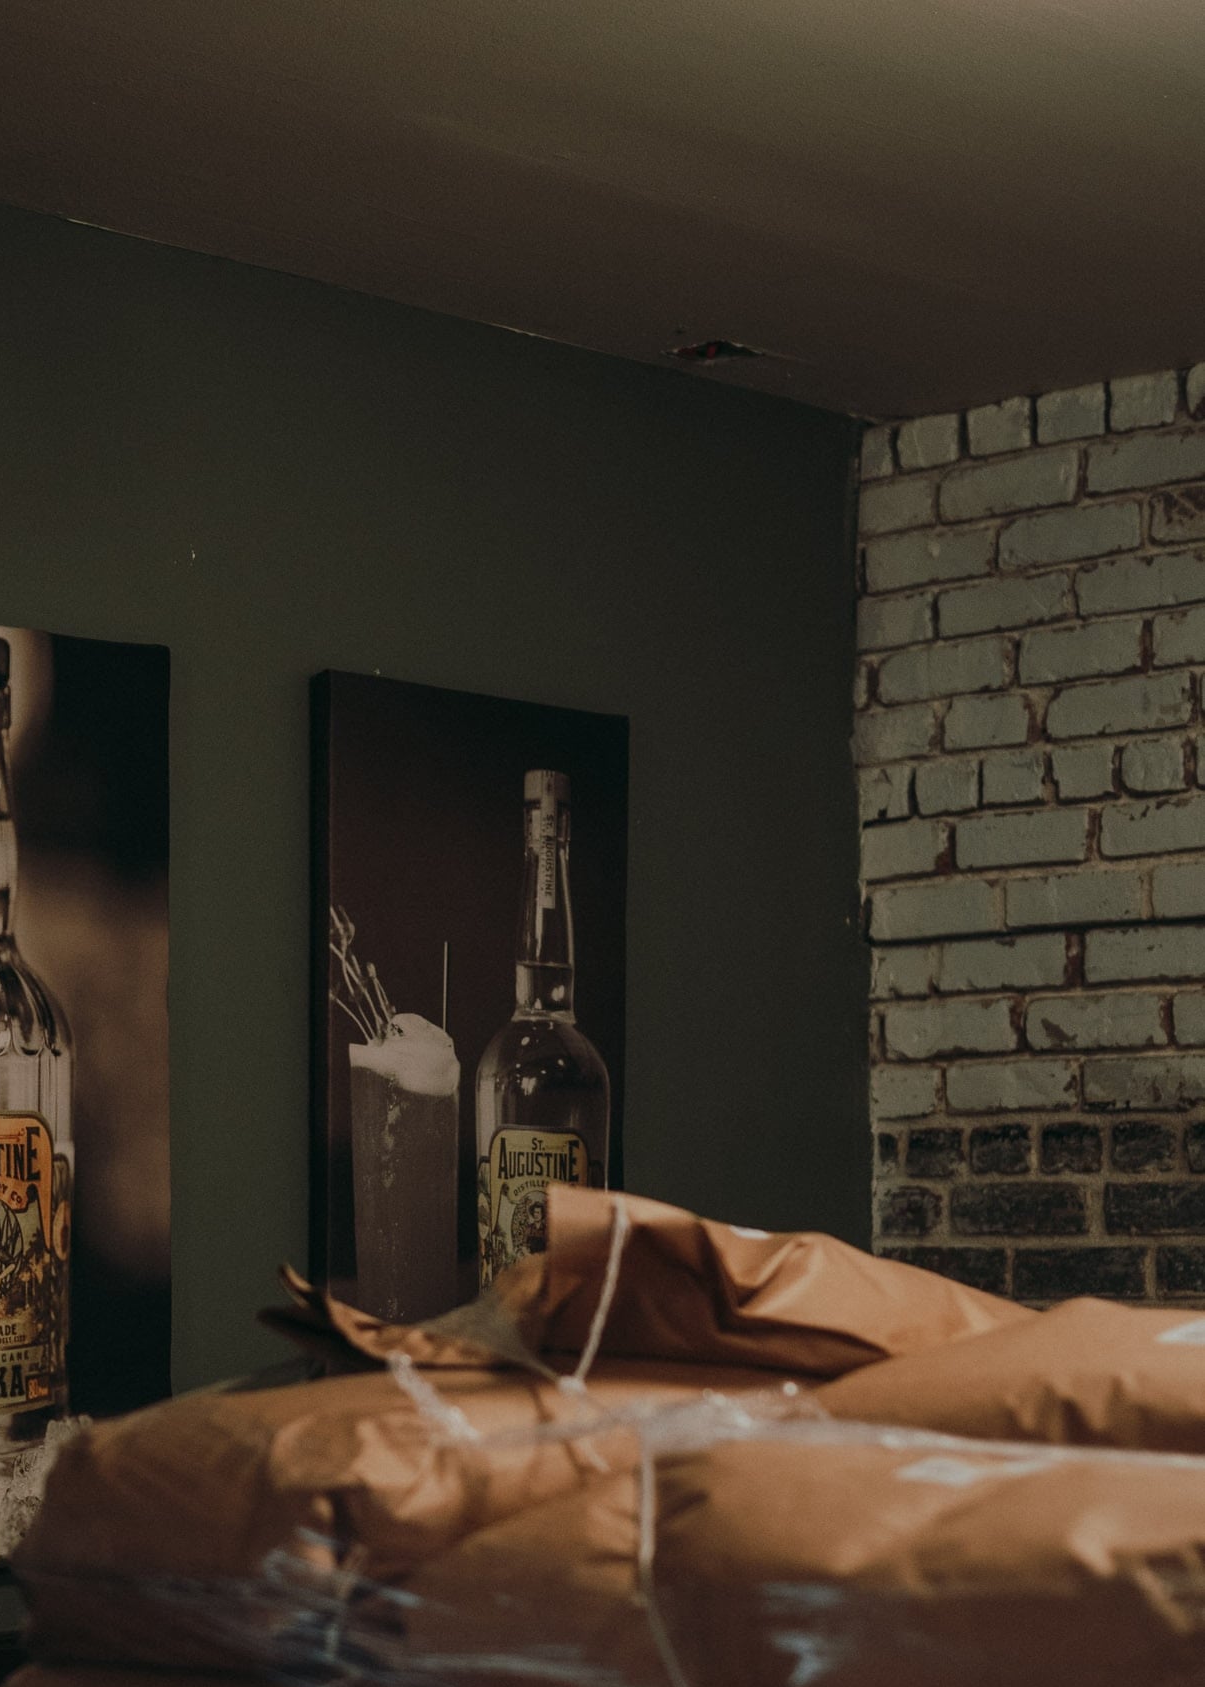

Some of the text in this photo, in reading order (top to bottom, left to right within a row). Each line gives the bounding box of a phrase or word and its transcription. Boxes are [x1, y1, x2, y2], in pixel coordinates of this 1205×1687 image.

[532, 1137, 545, 1151] ST.
[498, 1137, 580, 1182] AUGUSTINE
[1, 1350, 30, 1362] CANE
